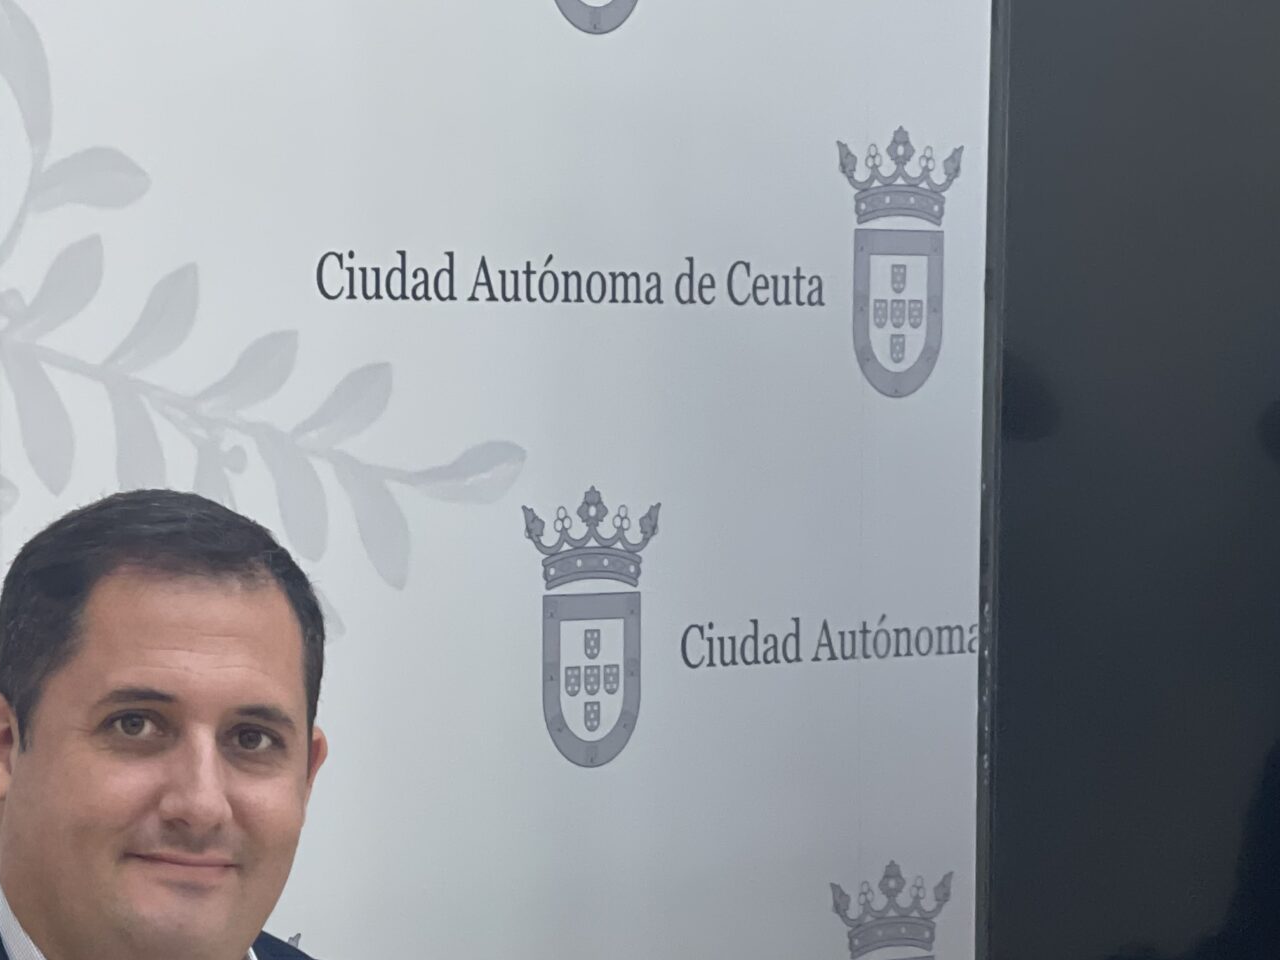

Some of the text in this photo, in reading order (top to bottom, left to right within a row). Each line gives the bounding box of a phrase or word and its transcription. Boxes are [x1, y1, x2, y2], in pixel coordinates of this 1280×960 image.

[315, 249, 826, 307] Ciudad Autónoma de Ceuta
[680, 616, 803, 669] Ciudad
